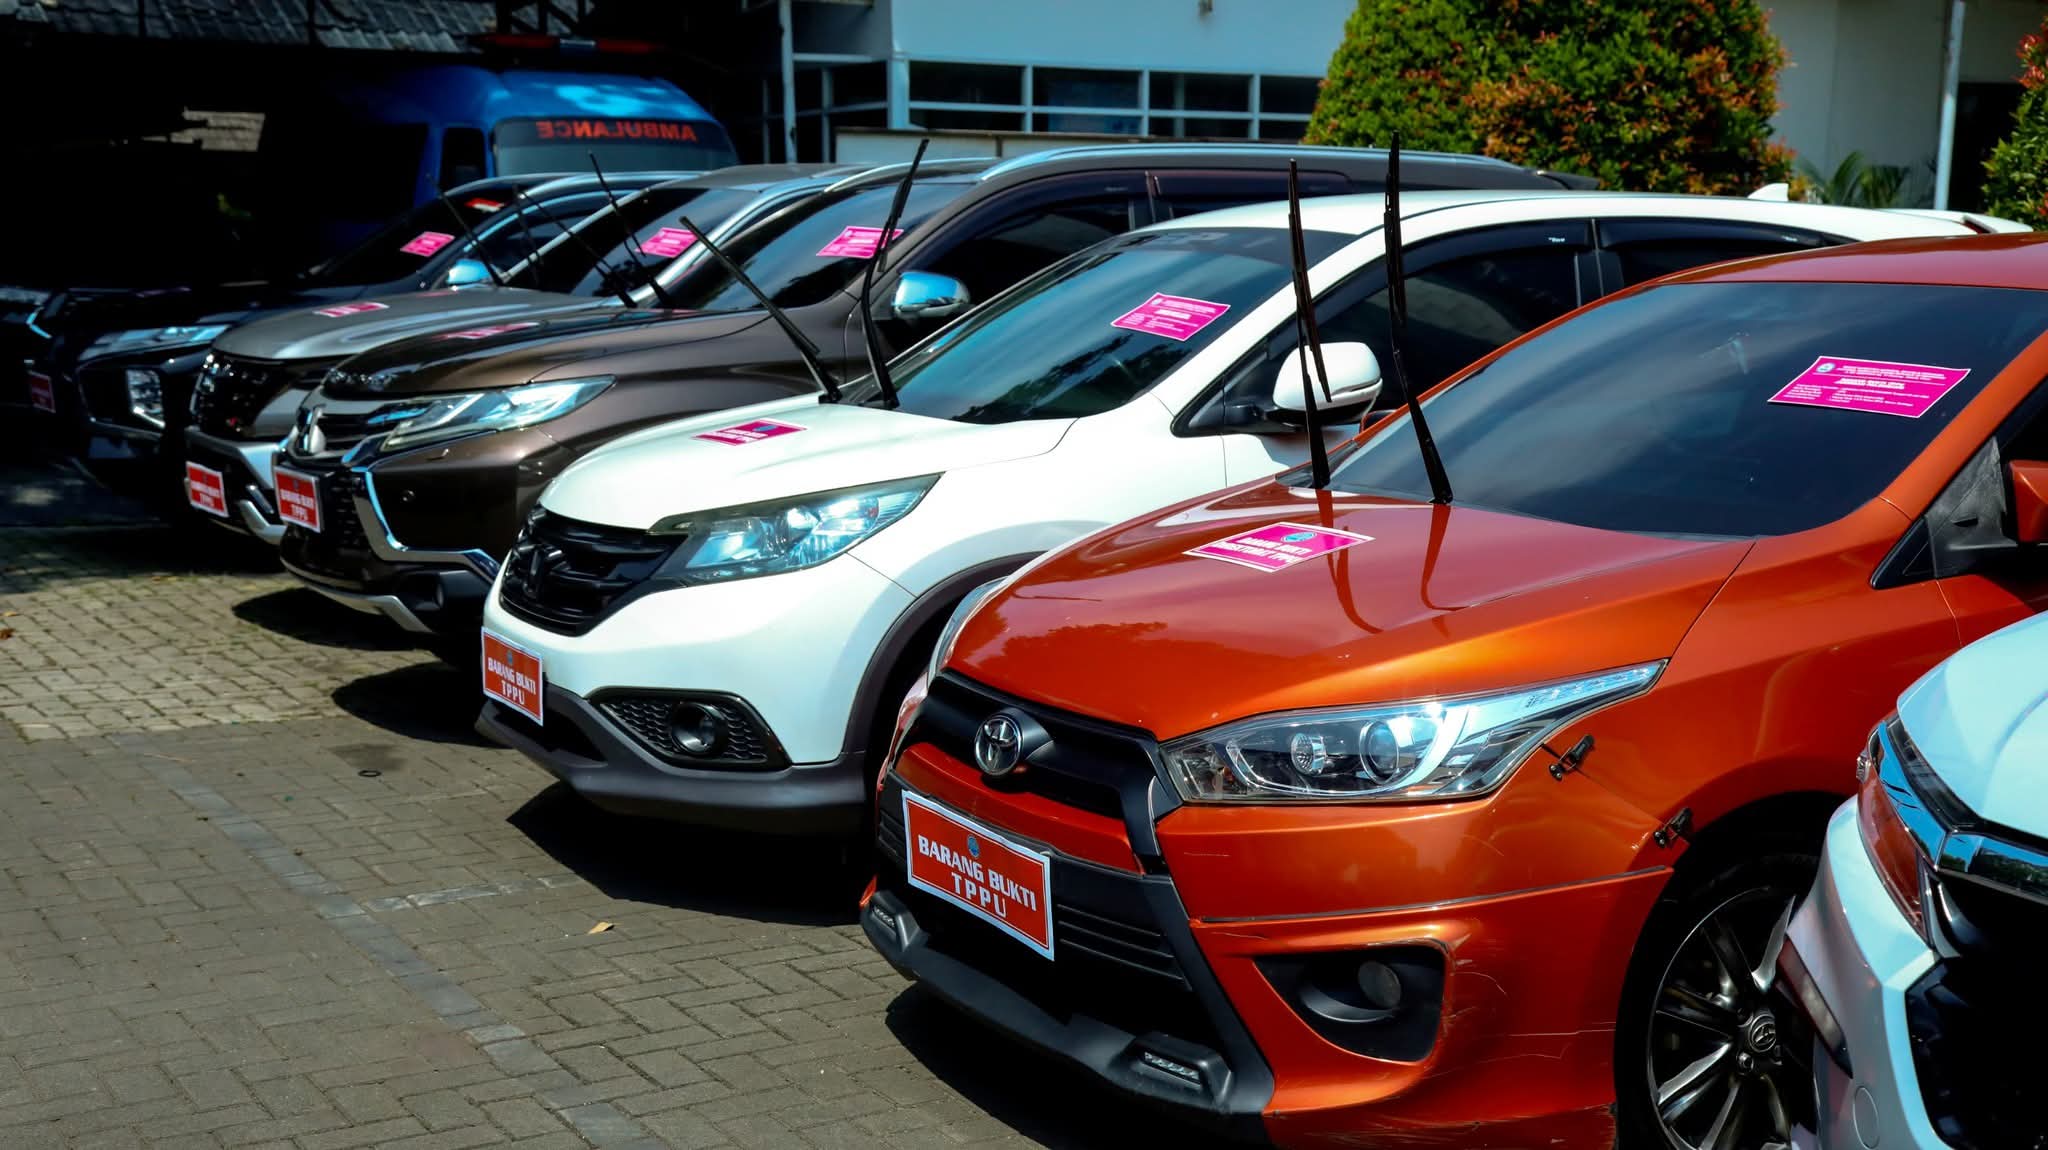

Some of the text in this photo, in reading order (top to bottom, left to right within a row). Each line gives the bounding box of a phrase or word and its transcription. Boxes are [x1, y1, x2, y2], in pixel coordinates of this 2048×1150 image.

[501, 680, 525, 705] TPPU
[918, 834, 1037, 912] BARANG BUKTI
[952, 872, 1007, 918] TPPU
